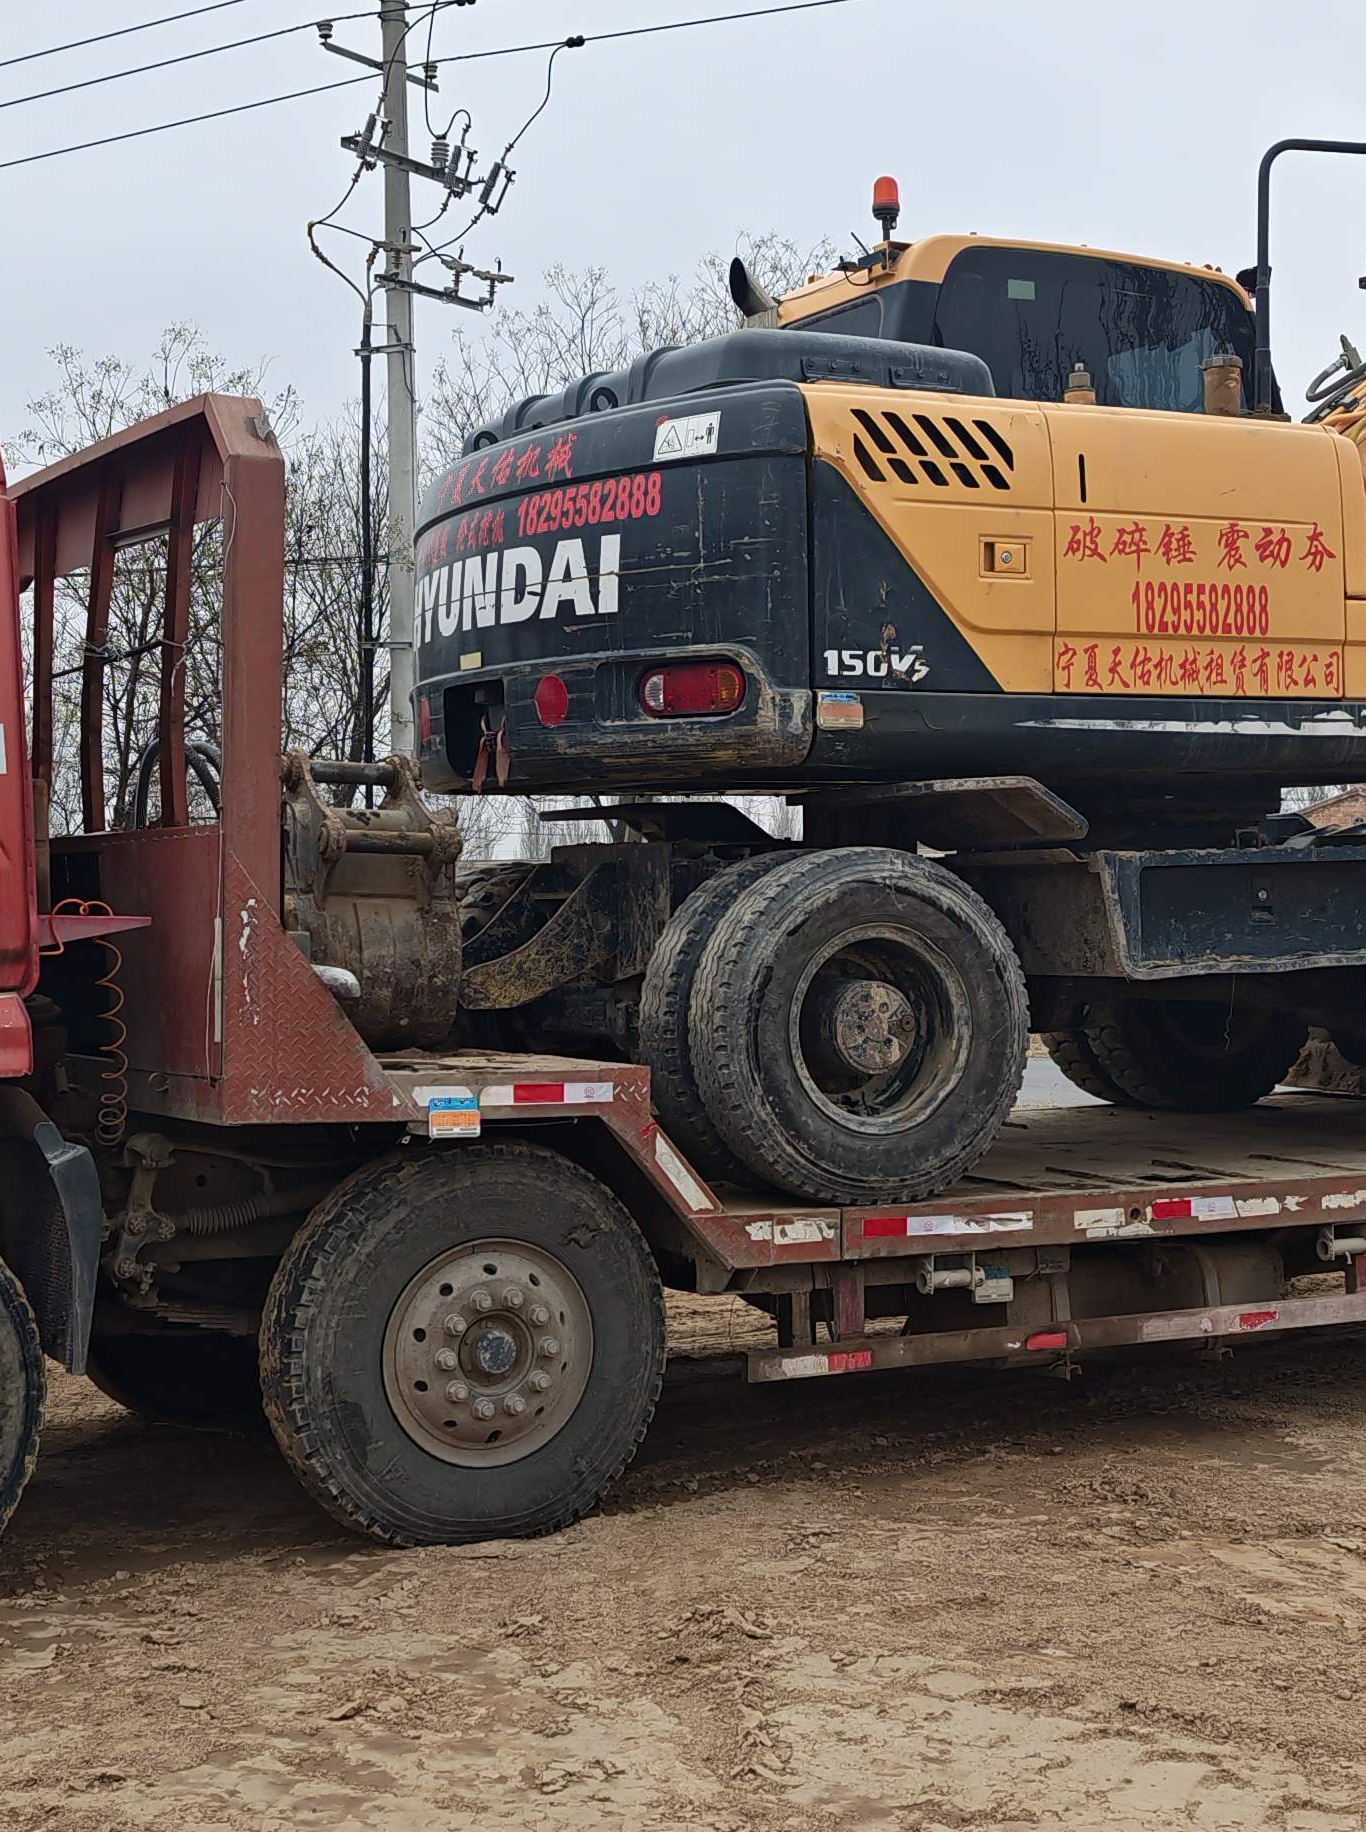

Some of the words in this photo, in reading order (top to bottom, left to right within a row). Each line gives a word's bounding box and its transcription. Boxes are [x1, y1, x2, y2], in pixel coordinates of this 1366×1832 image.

[517, 471, 662, 537] 18295582888
[1063, 516, 1197, 573] 破碎锤
[1217, 521, 1337, 573] 震动夯
[1132, 580, 1269, 636] 18295582888
[1056, 642, 1341, 697] 宁夏天佑机械租赁有限公司
